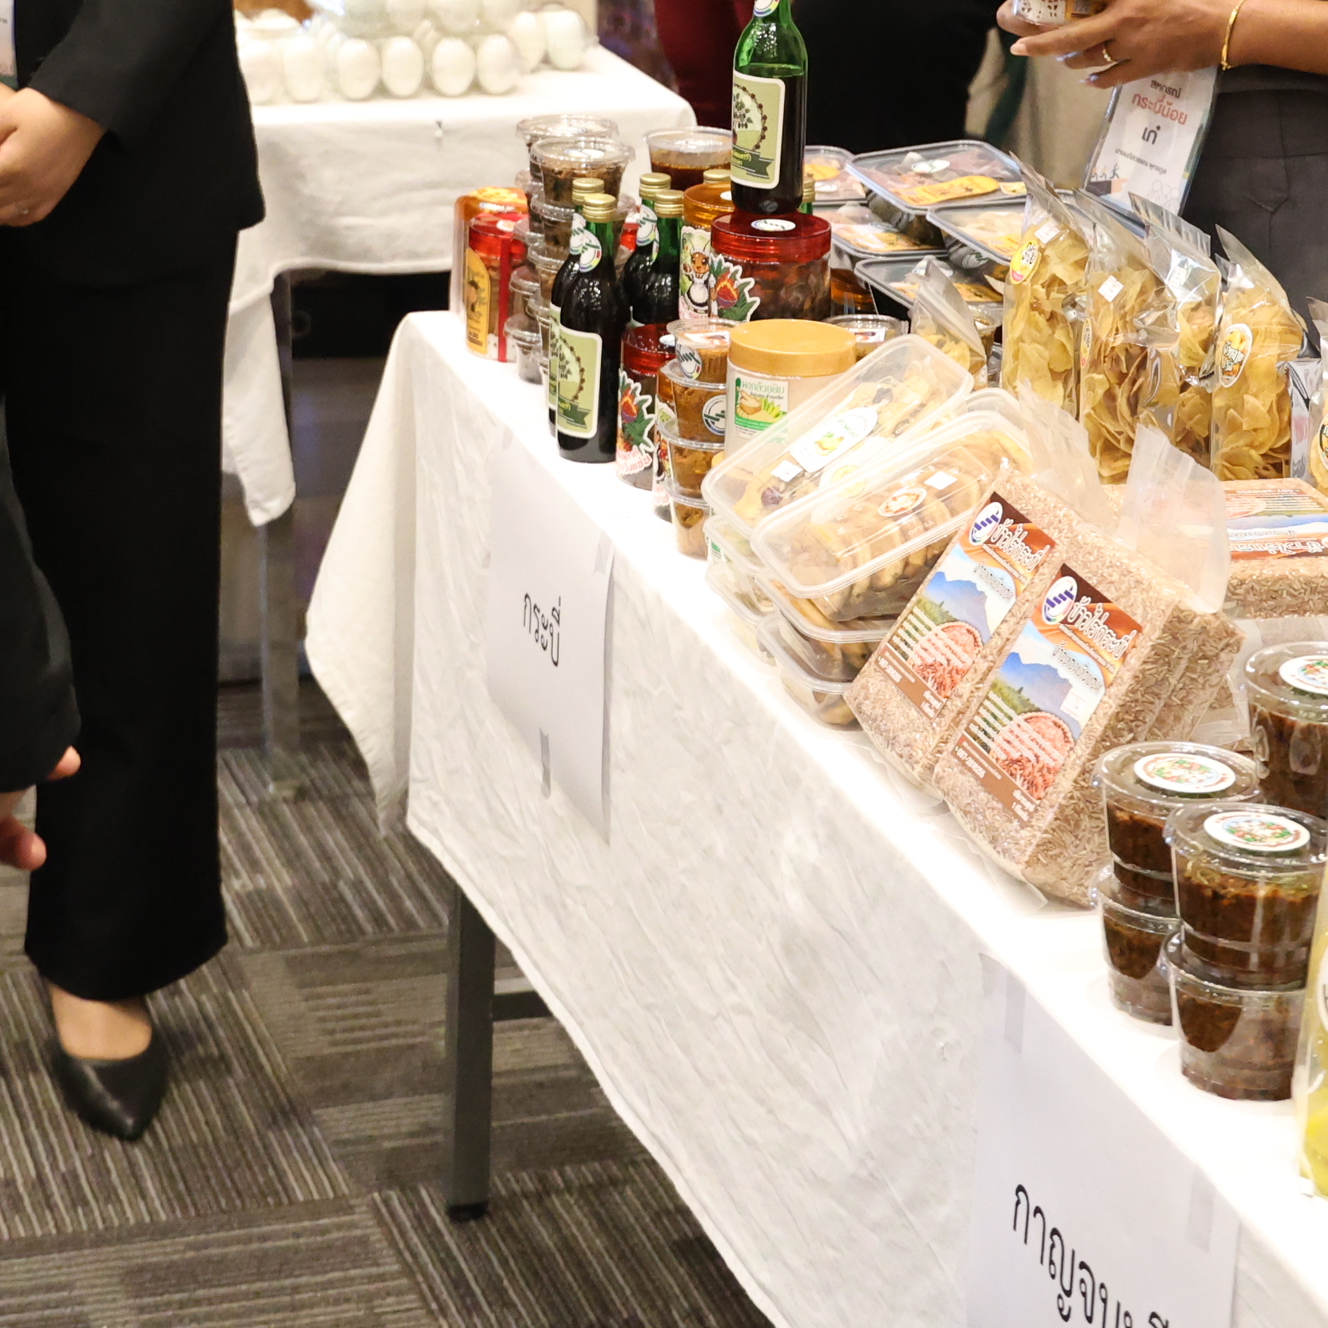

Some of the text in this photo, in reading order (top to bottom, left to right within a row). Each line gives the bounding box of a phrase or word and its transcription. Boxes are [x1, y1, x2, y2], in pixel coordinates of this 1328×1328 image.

[990, 518, 1051, 573] ข้าวไร่กระบี่
[523, 592, 561, 667] กระบี่
[1070, 596, 1138, 661] ข้าวไร่กระบี่
